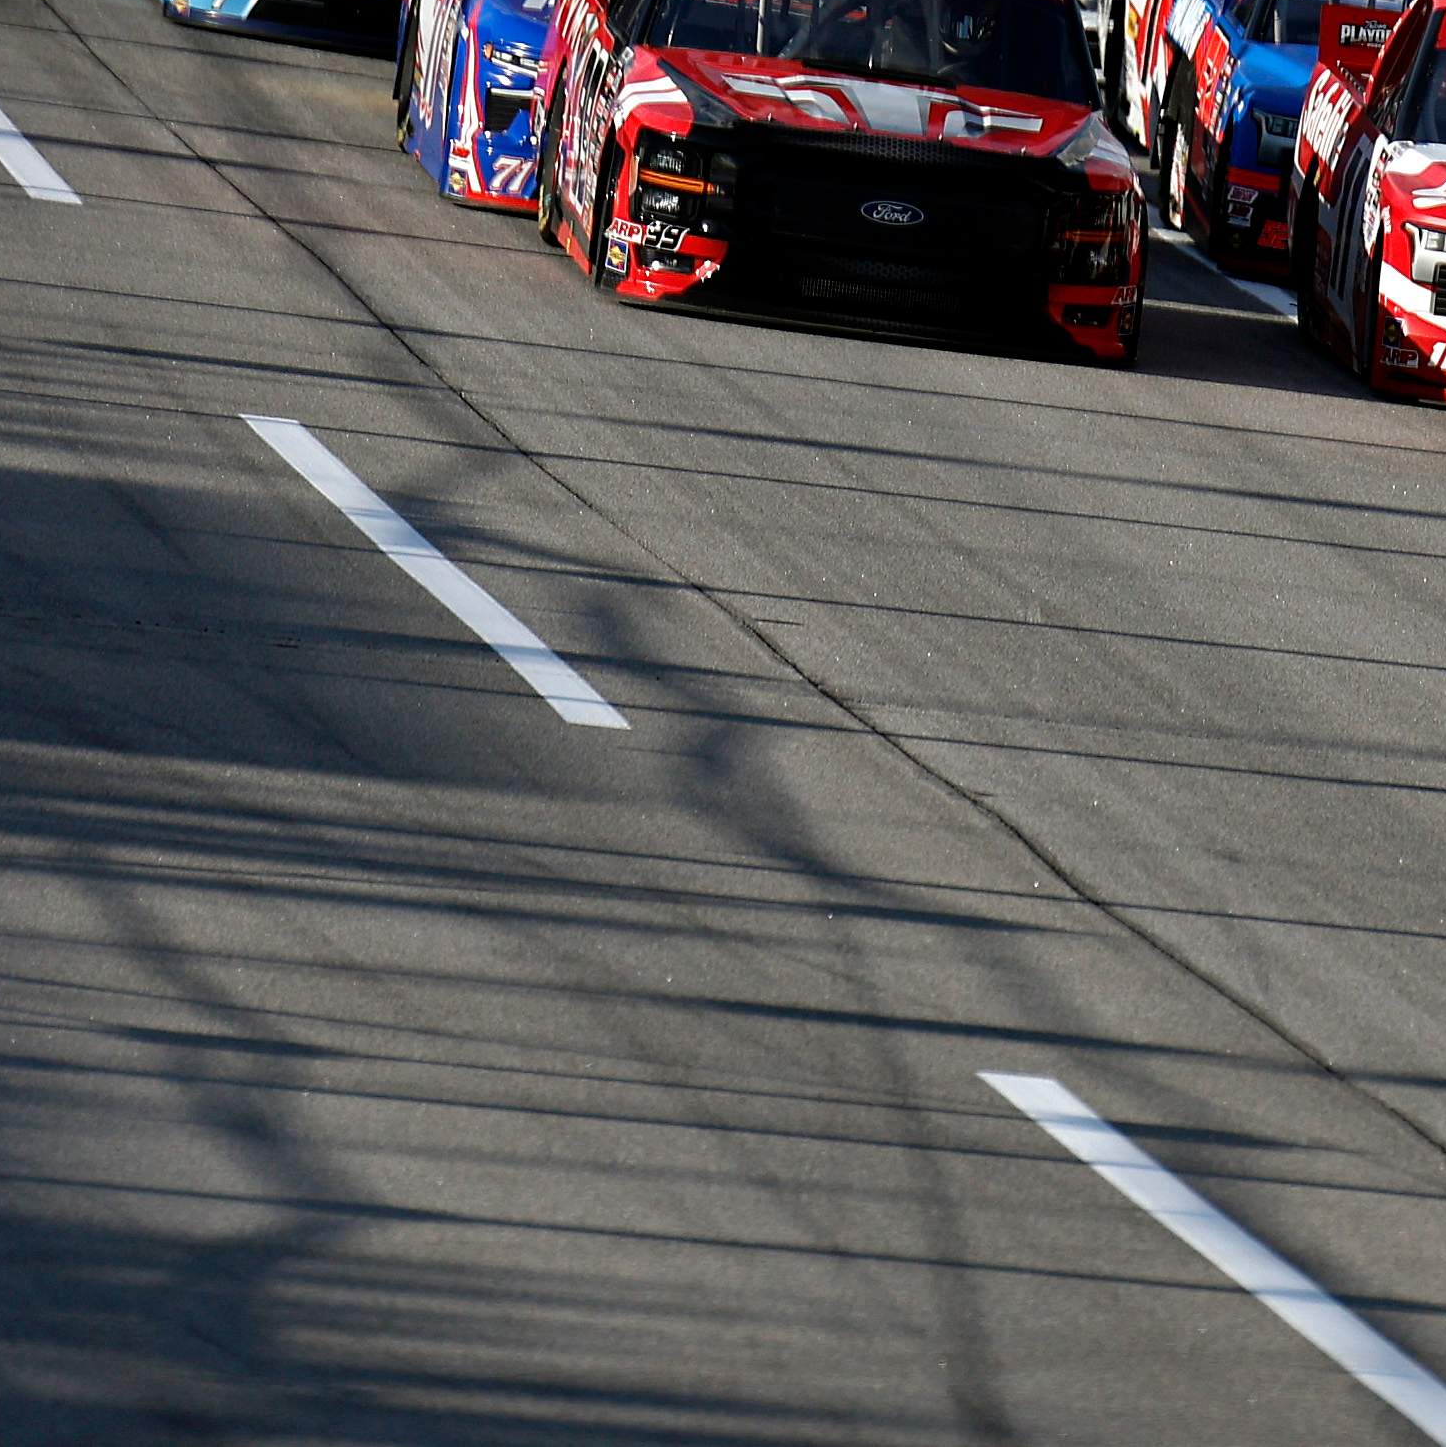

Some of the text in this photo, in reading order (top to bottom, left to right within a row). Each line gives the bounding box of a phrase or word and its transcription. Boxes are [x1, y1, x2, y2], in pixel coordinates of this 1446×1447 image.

[491, 155, 535, 195] 71
[873, 203, 913, 224] Ford
[609, 218, 642, 240] ARP
